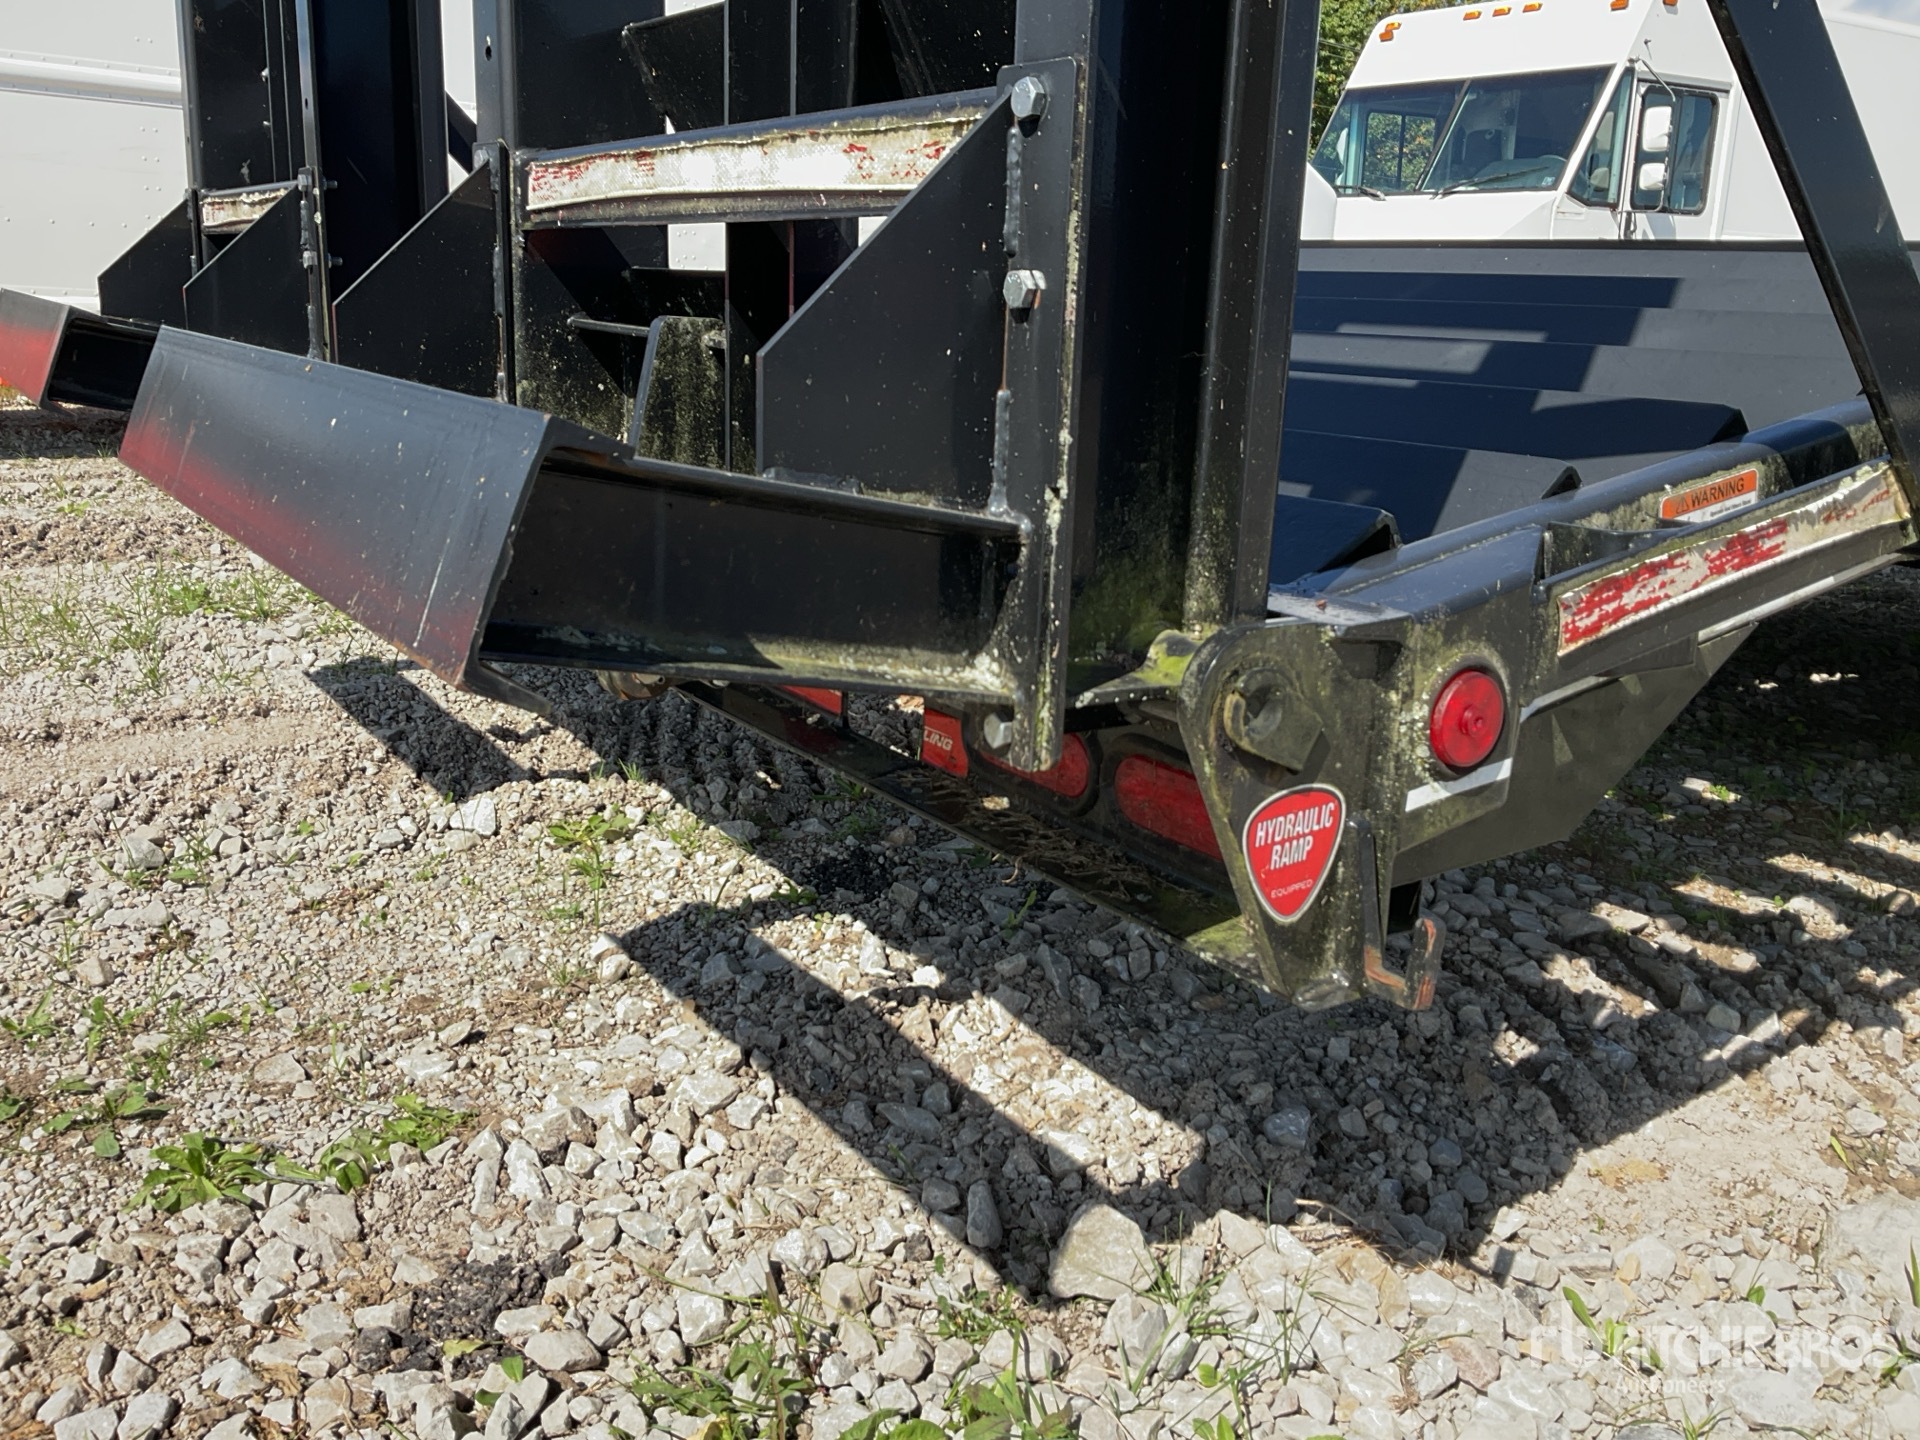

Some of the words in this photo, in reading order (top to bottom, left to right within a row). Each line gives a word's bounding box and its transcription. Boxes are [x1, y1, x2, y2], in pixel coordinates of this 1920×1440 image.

[1691, 477, 1744, 508] WARNING
[1255, 802, 1335, 848] HYDRAULIC
[1270, 835, 1314, 870] RAMP
[1270, 879, 1313, 899] EQUIPPED
